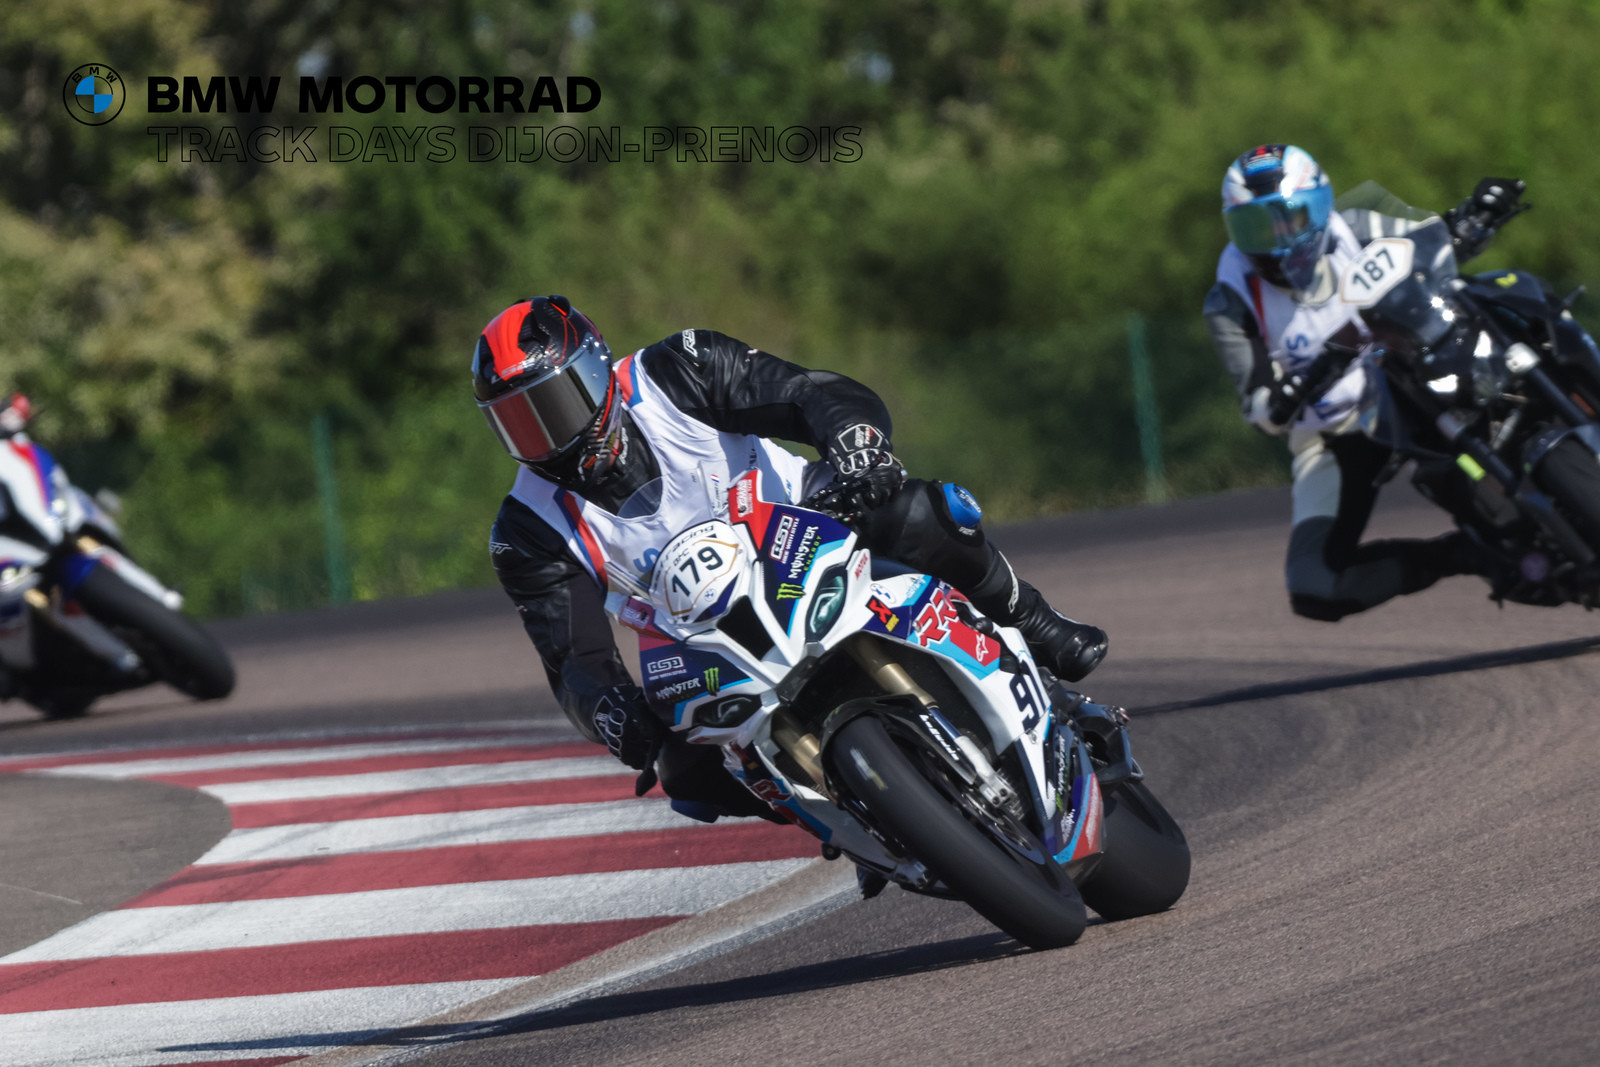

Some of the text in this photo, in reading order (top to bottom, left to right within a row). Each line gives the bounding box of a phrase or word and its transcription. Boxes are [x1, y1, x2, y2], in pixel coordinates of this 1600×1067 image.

[1352, 247, 1395, 290] 187
[671, 546, 723, 597] 179
[788, 526, 819, 578] MONSTER
